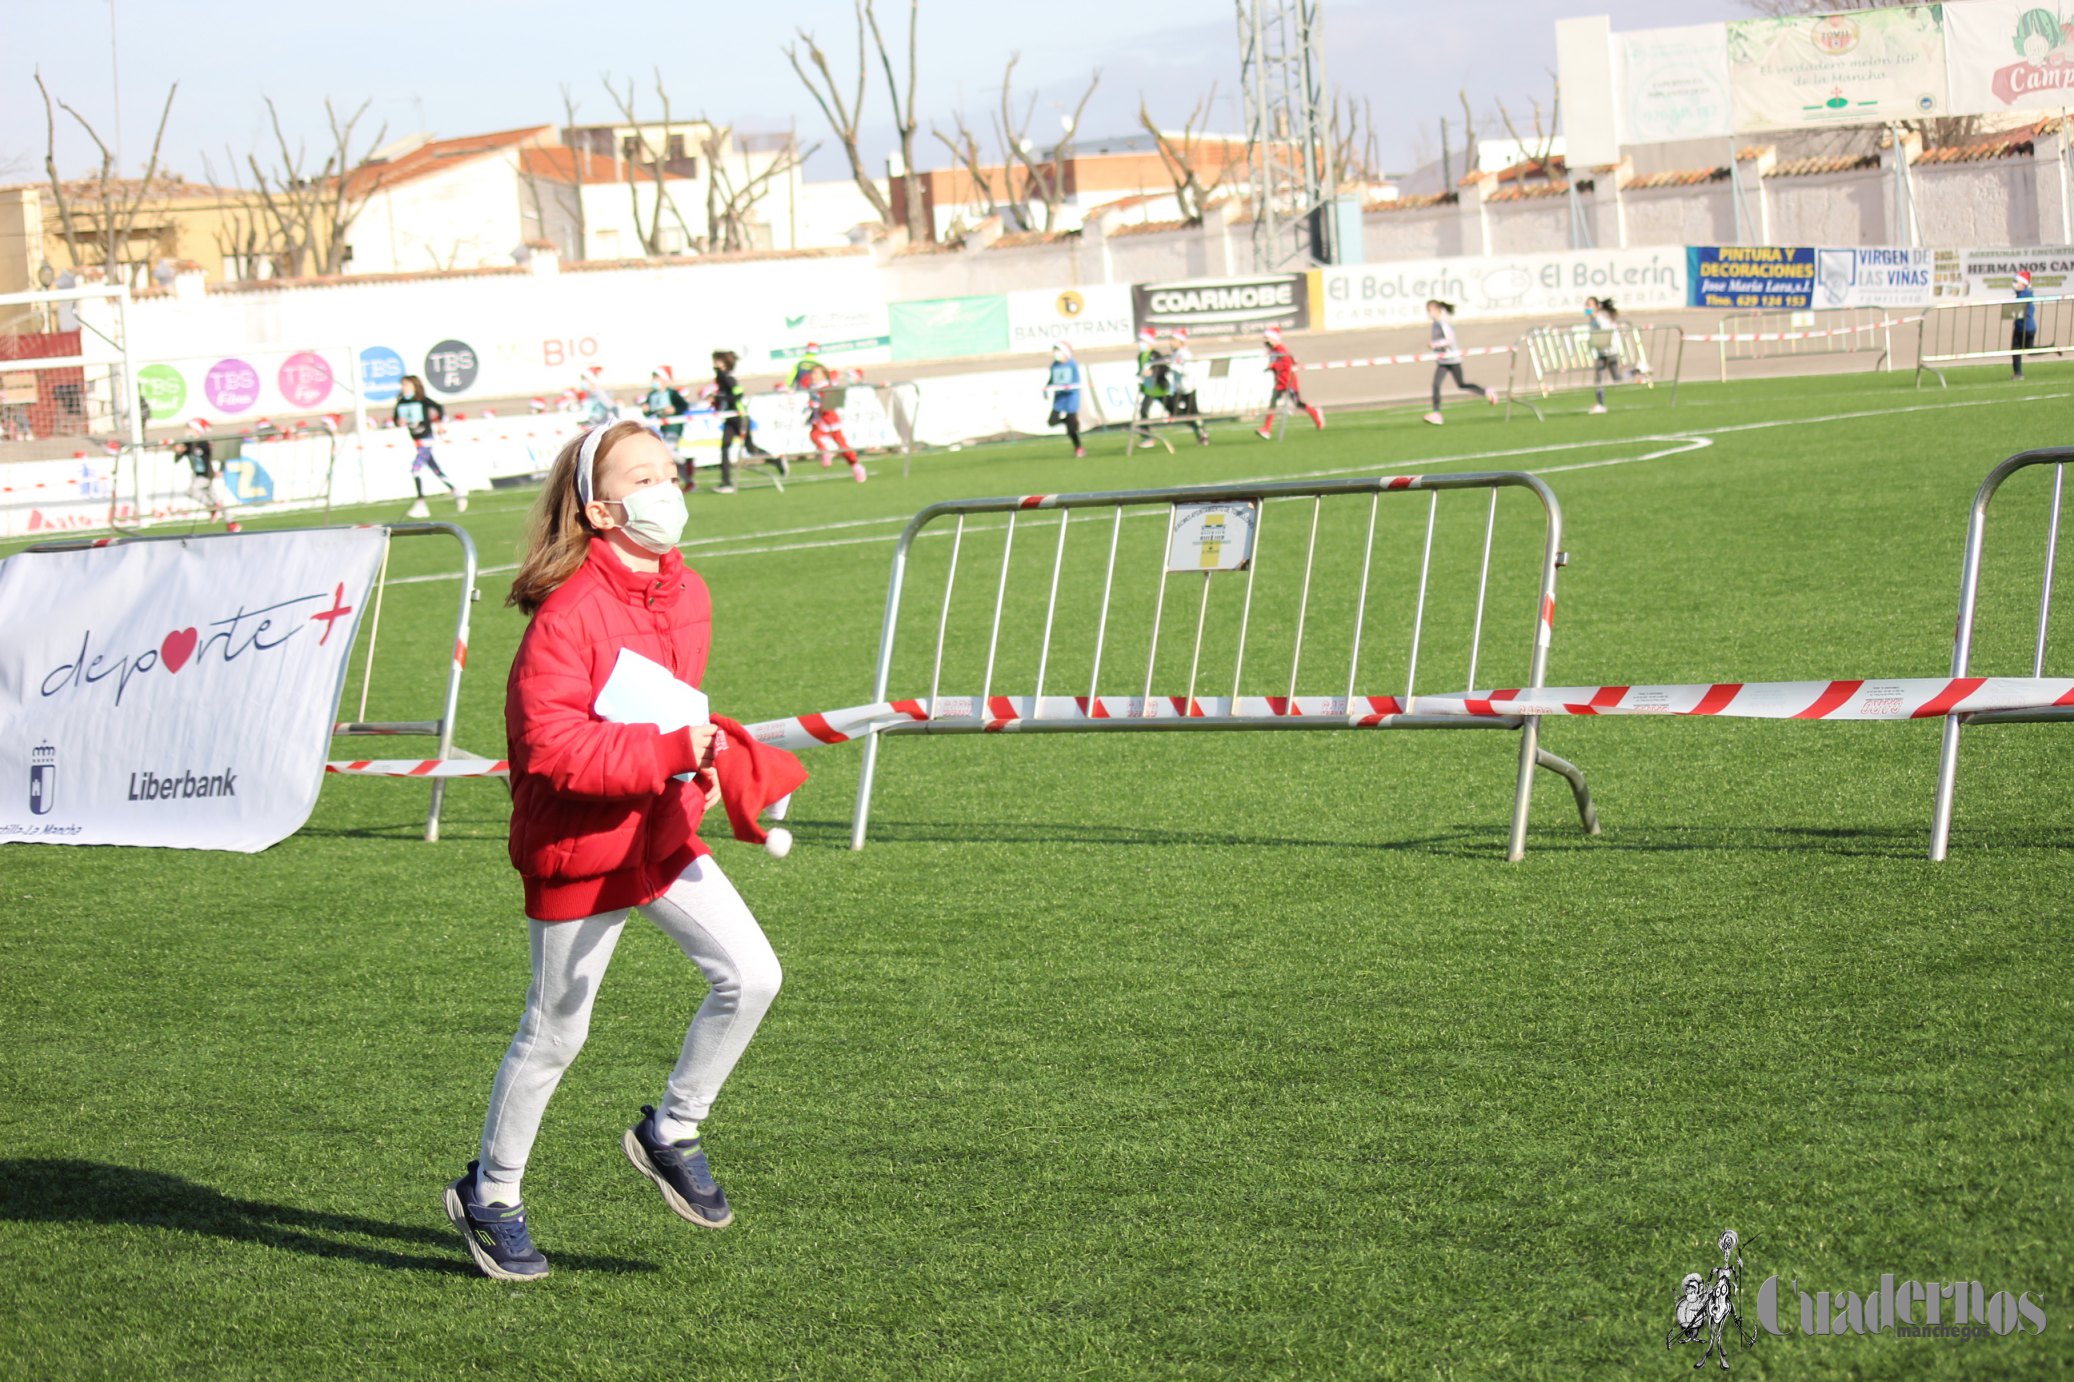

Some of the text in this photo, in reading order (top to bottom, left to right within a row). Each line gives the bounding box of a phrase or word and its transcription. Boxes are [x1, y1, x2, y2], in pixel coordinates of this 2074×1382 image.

[1719, 248, 1796, 261] PINTURA Y
[1859, 249, 1930, 265] VIRGEN DE
[1700, 262, 1814, 278] DECORACIONES
[1859, 267, 1929, 286] LAS VIÑAS
[1967, 261, 2046, 275] HERMANOS
[1151, 283, 1293, 313] COARMOBE
[1014, 318, 1130, 341] BANDYTRANS
[430, 351, 475, 373] TBS
[210, 370, 255, 391] TBS
[283, 363, 328, 385] TBS
[128, 767, 238, 801] Liberbank
